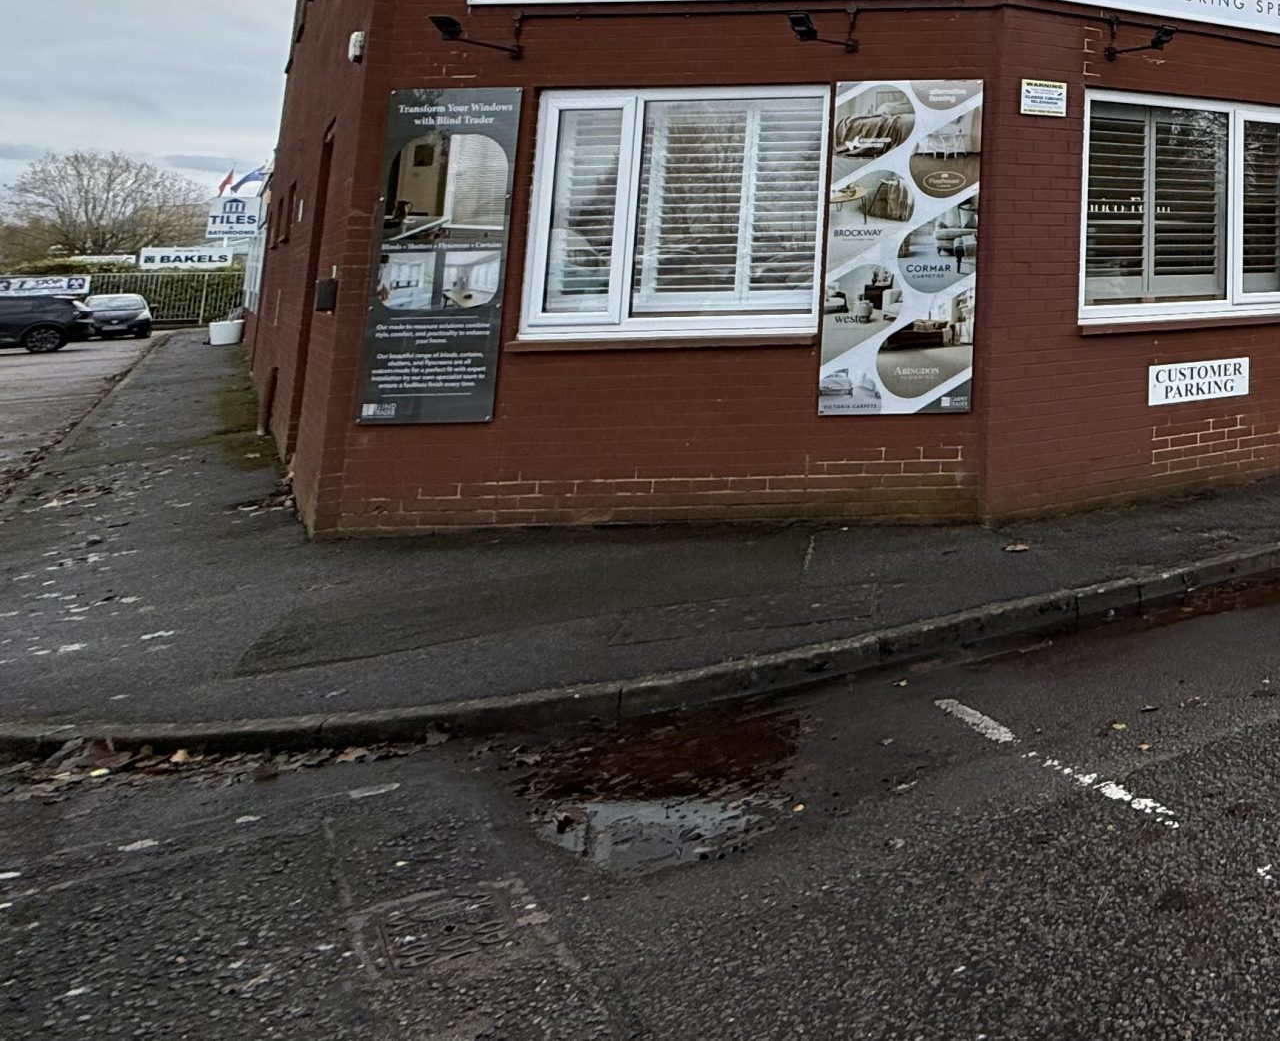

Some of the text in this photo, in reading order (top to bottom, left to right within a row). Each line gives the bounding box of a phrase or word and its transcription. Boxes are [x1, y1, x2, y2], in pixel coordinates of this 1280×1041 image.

[398, 102, 513, 113] Transform Your Windows
[414, 115, 495, 125] with Blind Trader
[209, 215, 257, 225] TILES
[833, 229, 883, 237] BROCKWAY
[160, 254, 229, 264] BAKELS
[906, 264, 952, 273] CORMAR
[1155, 362, 1243, 385] CUSTOMER
[1164, 378, 1235, 400] PARKING
